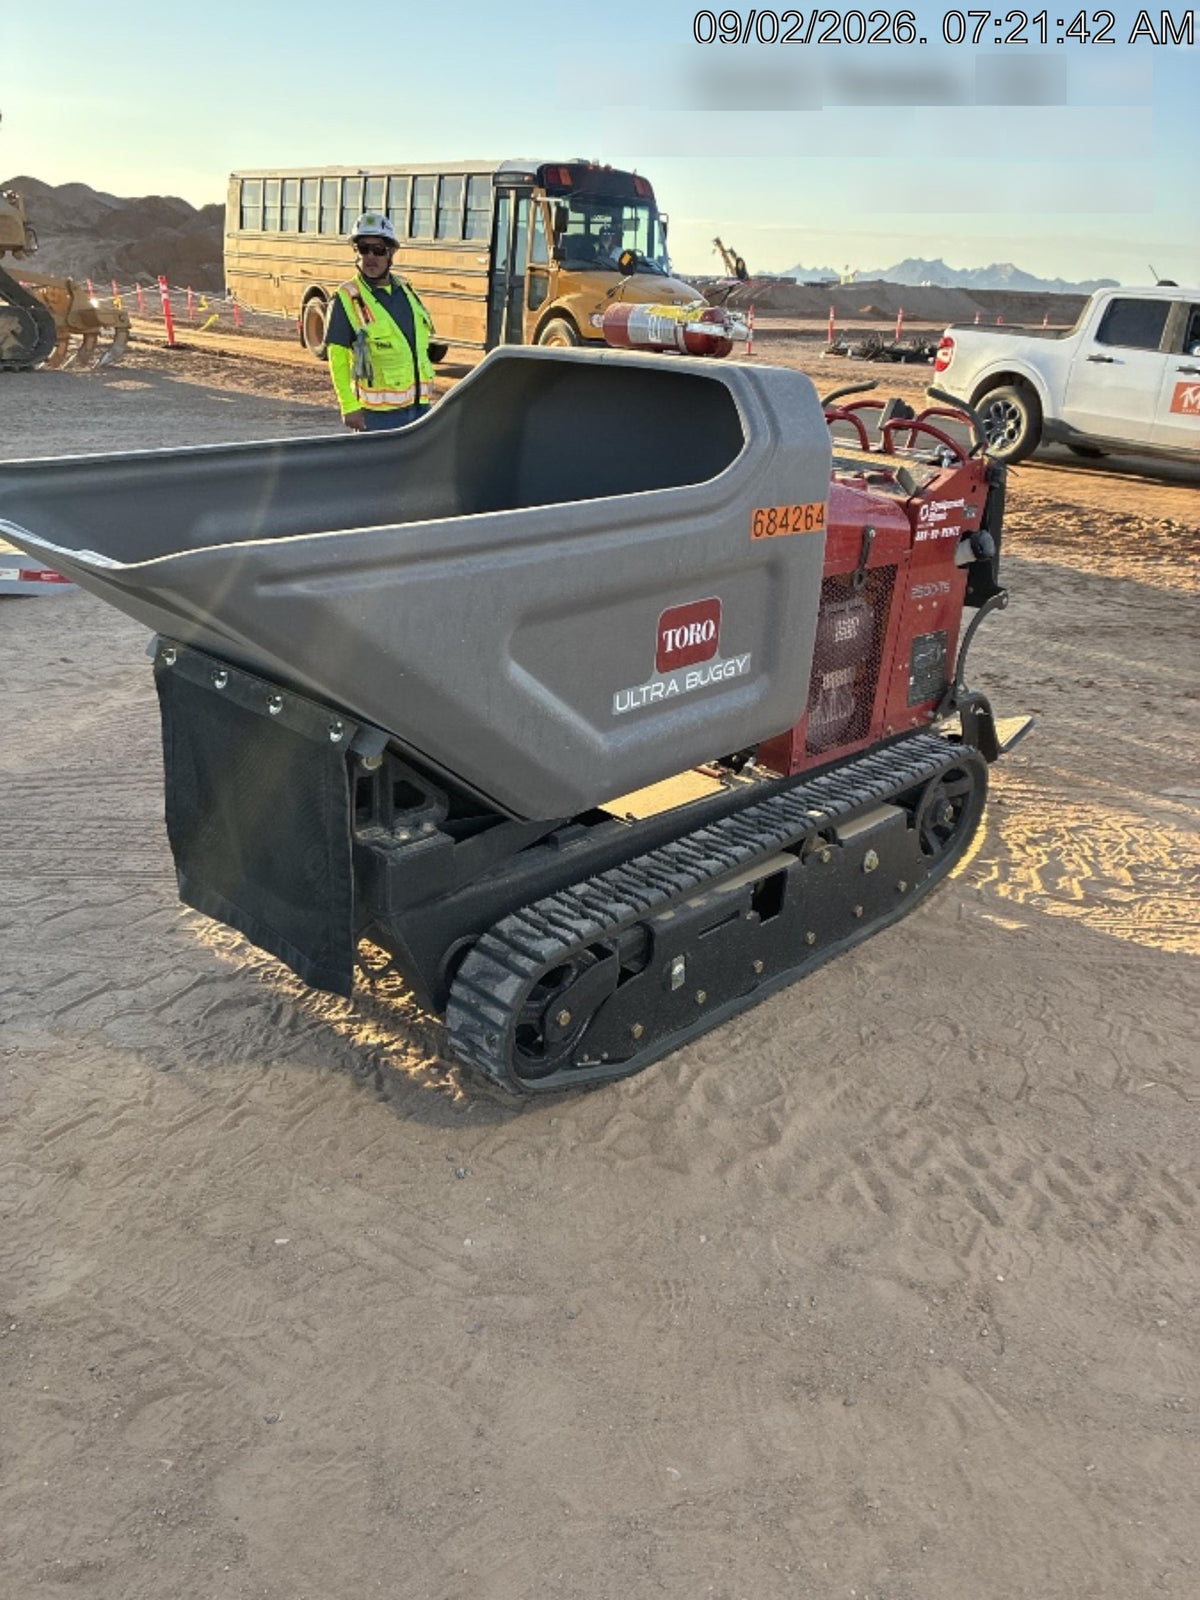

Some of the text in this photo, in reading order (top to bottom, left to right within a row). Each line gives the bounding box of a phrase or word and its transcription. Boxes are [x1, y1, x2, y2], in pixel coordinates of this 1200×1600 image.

[753, 504, 825, 538] 684264
[662, 619, 716, 654] TORO
[616, 655, 748, 711] ULTRA BUGGY
